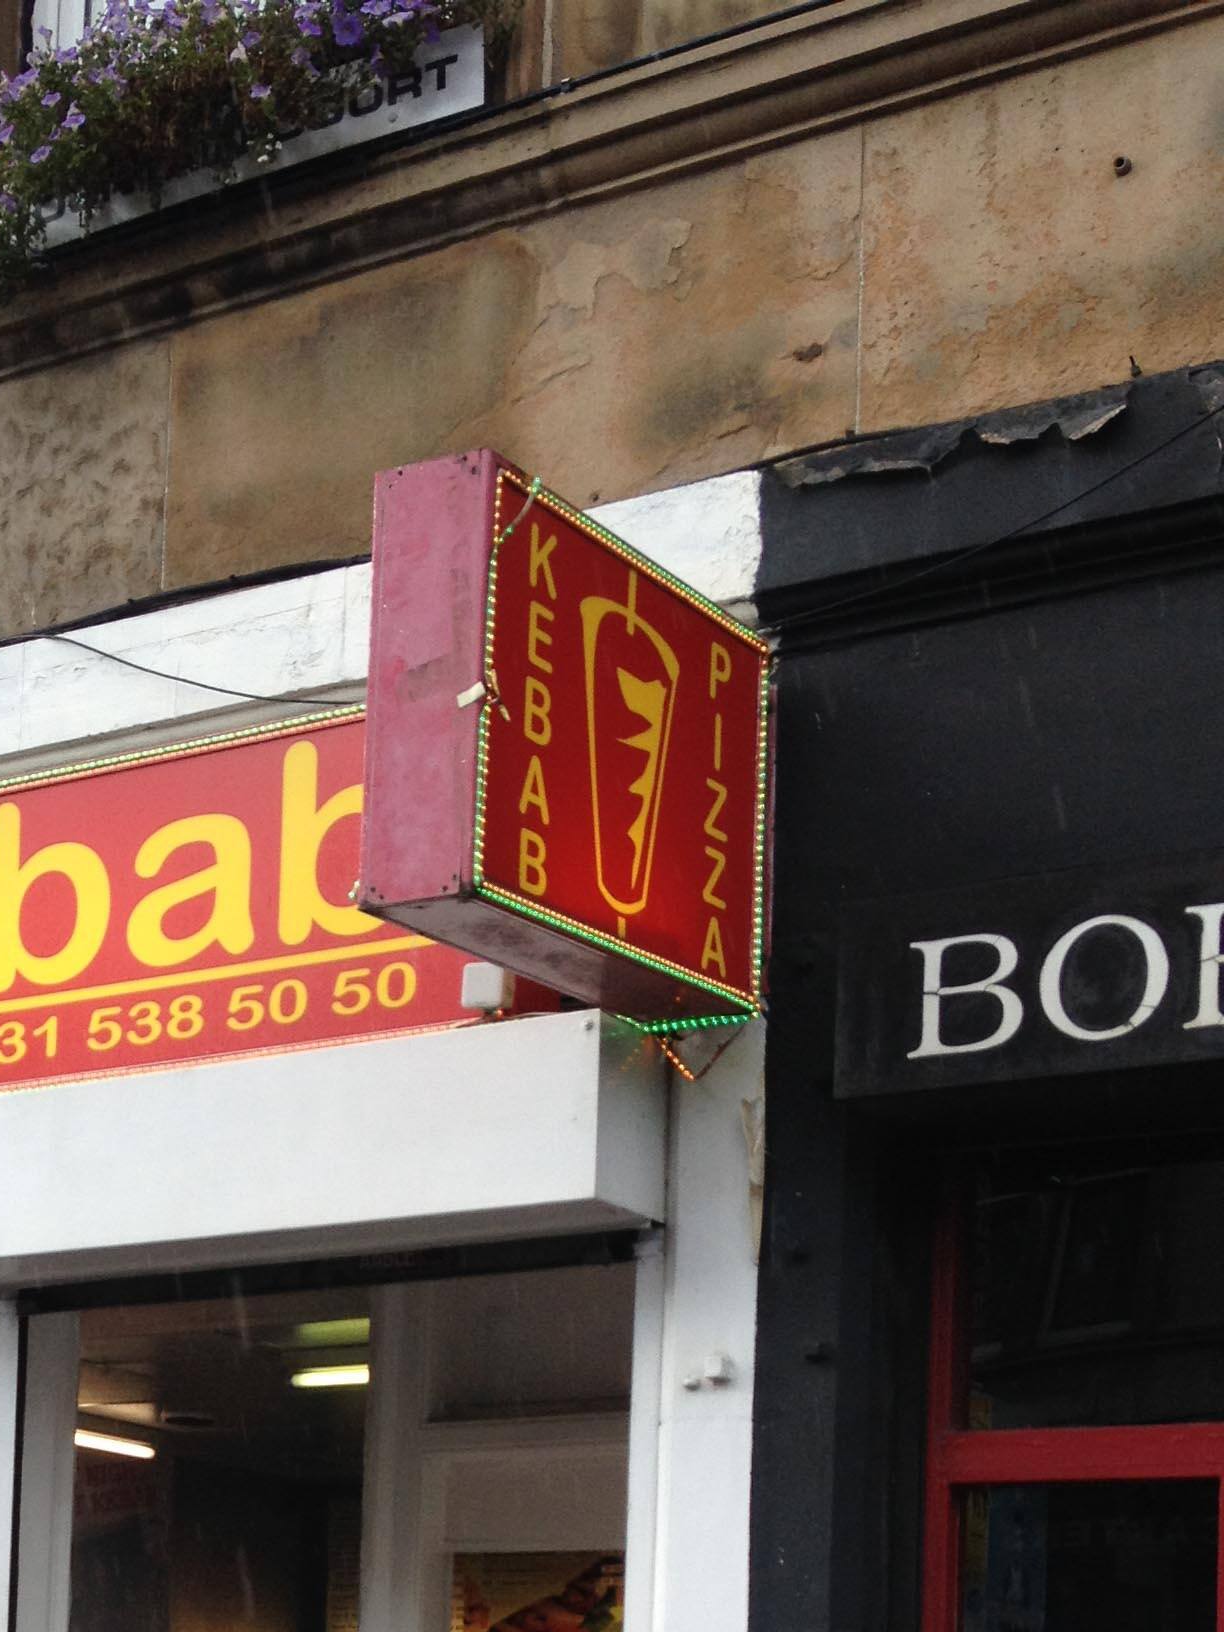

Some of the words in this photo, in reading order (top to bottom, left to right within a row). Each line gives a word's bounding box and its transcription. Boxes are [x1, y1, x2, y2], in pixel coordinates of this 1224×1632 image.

[519, 523, 558, 897] KEBAB
[701, 642, 732, 978] PIZZA
[87, 994, 205, 1051] 538
[226, 979, 308, 1031] 50
[330, 962, 418, 1017] 50
